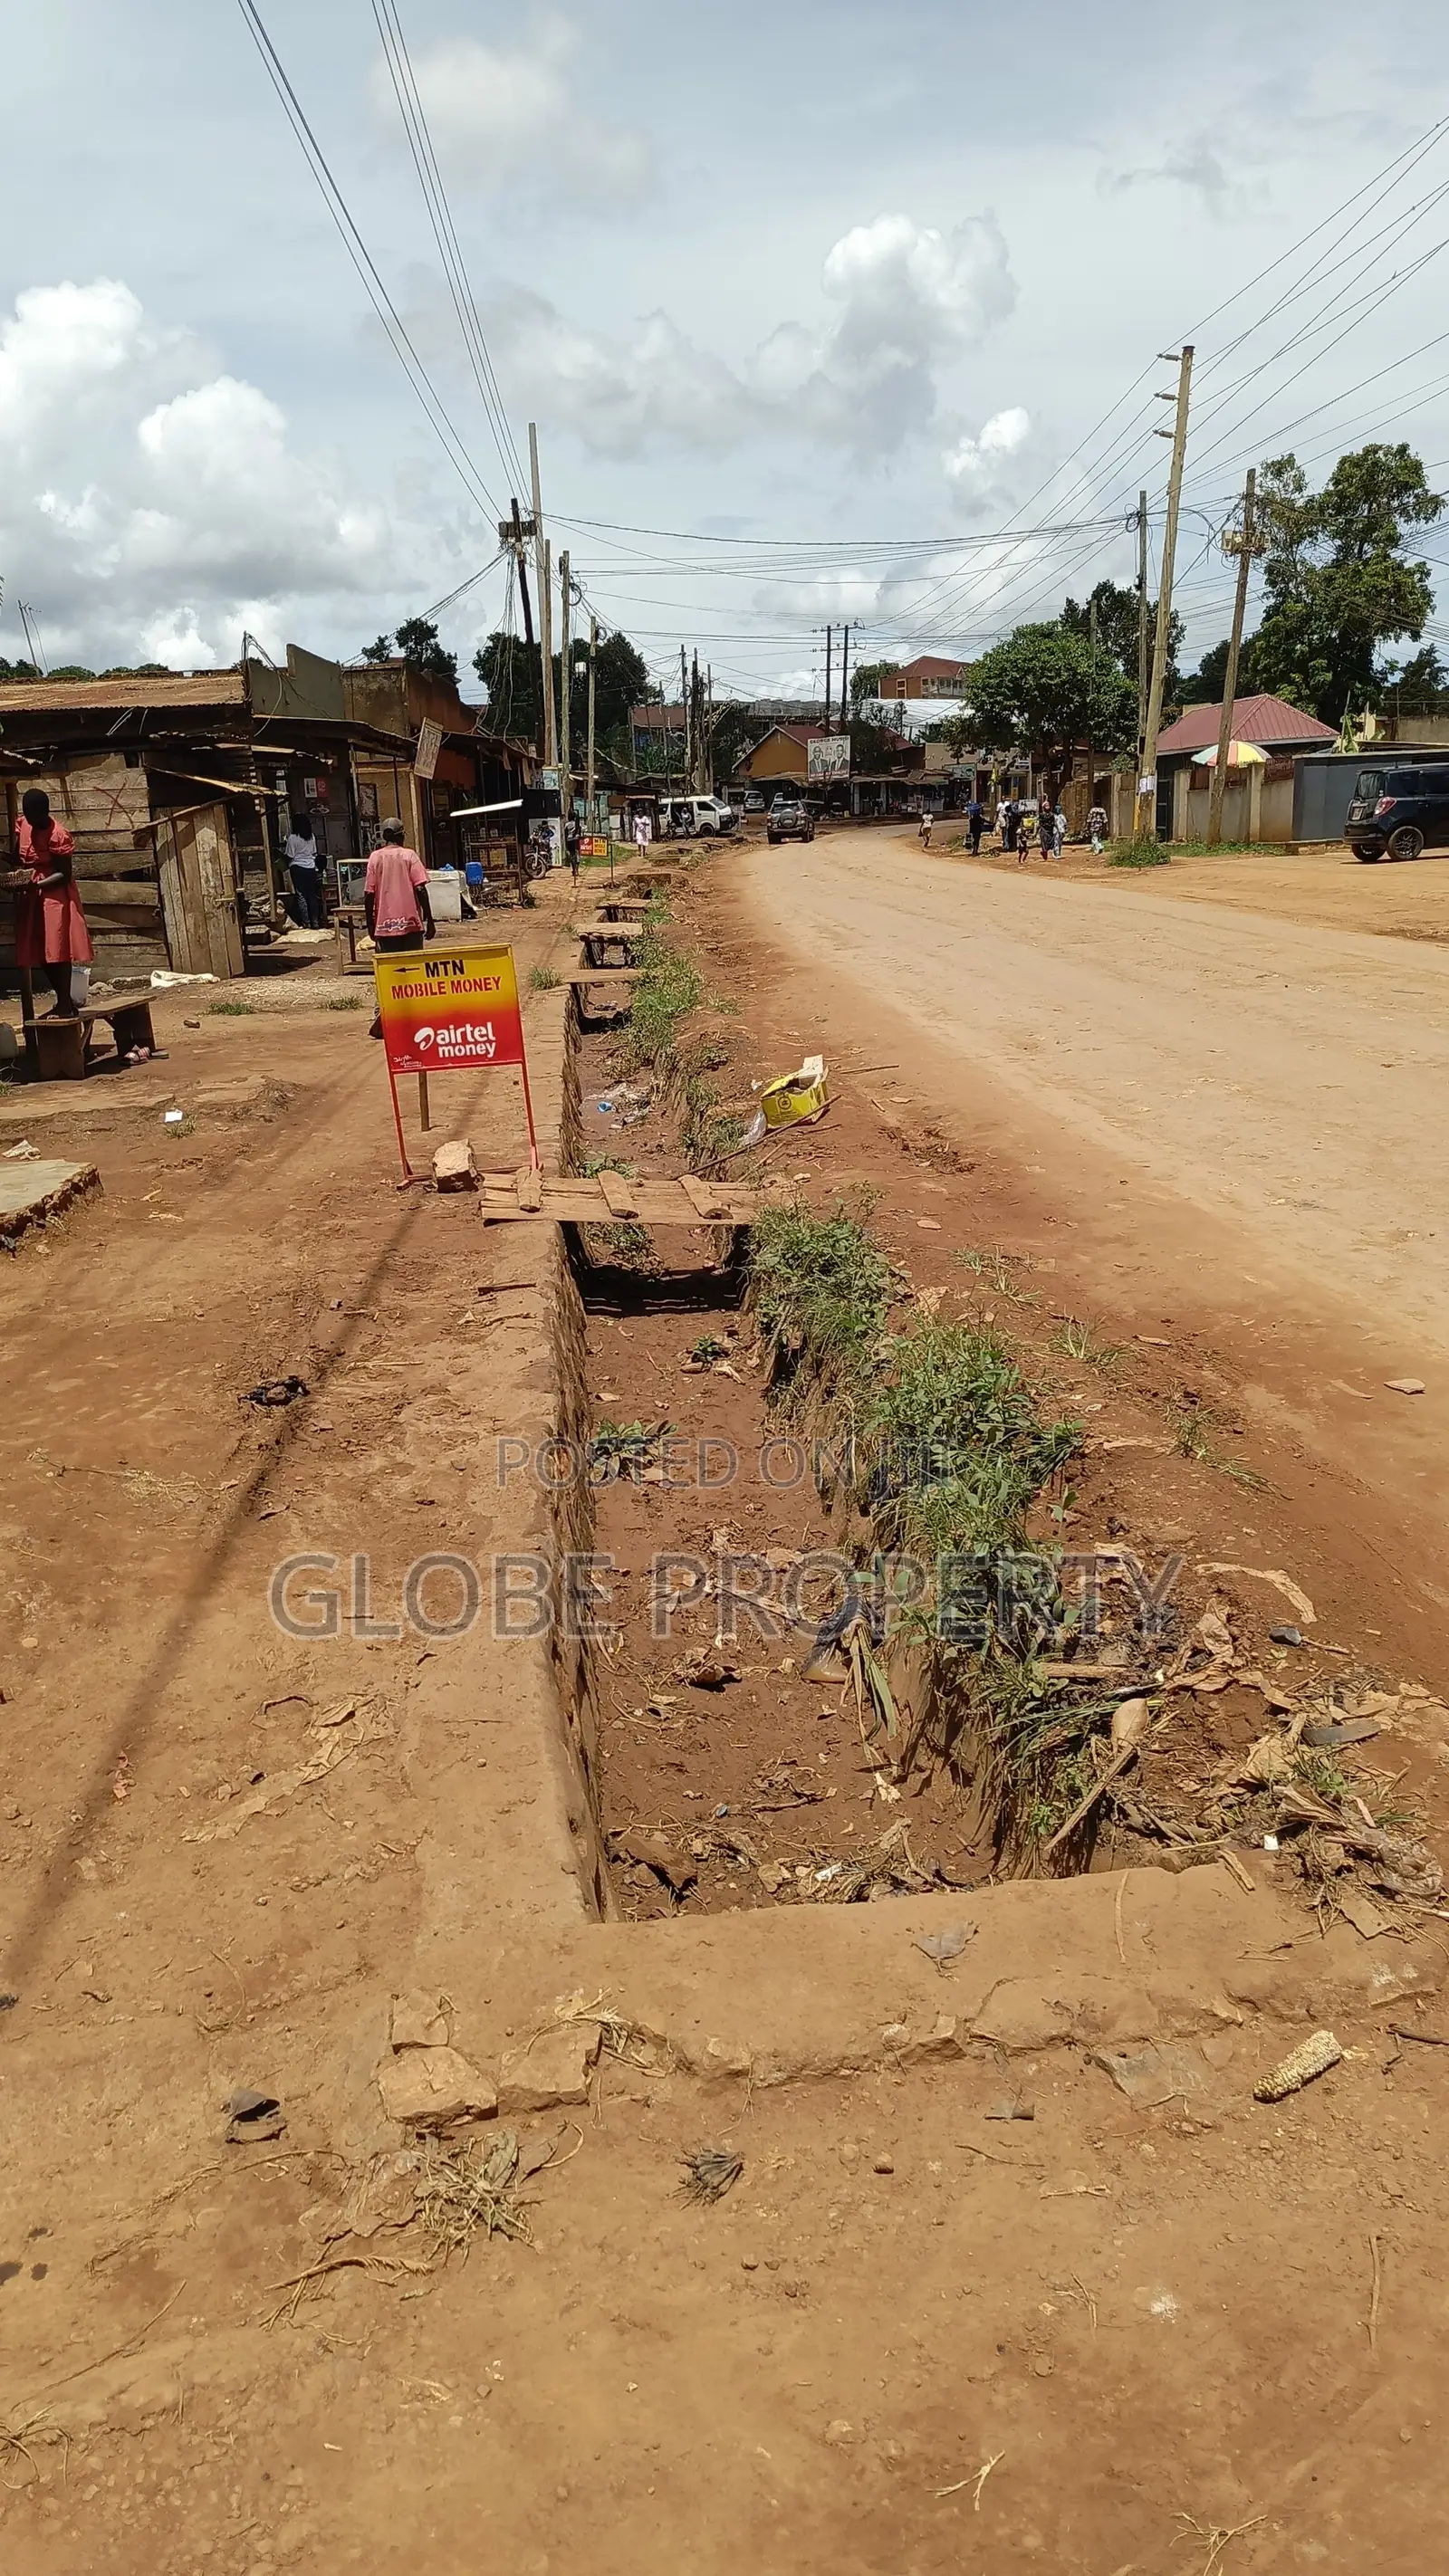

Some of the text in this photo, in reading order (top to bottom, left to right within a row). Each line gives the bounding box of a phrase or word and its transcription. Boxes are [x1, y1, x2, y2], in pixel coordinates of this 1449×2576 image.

[425, 959, 465, 978] MTN
[391, 976, 502, 1000] MOBILE MONEY
[436, 1021, 496, 1045] airtel
[438, 1042, 496, 1058] money
